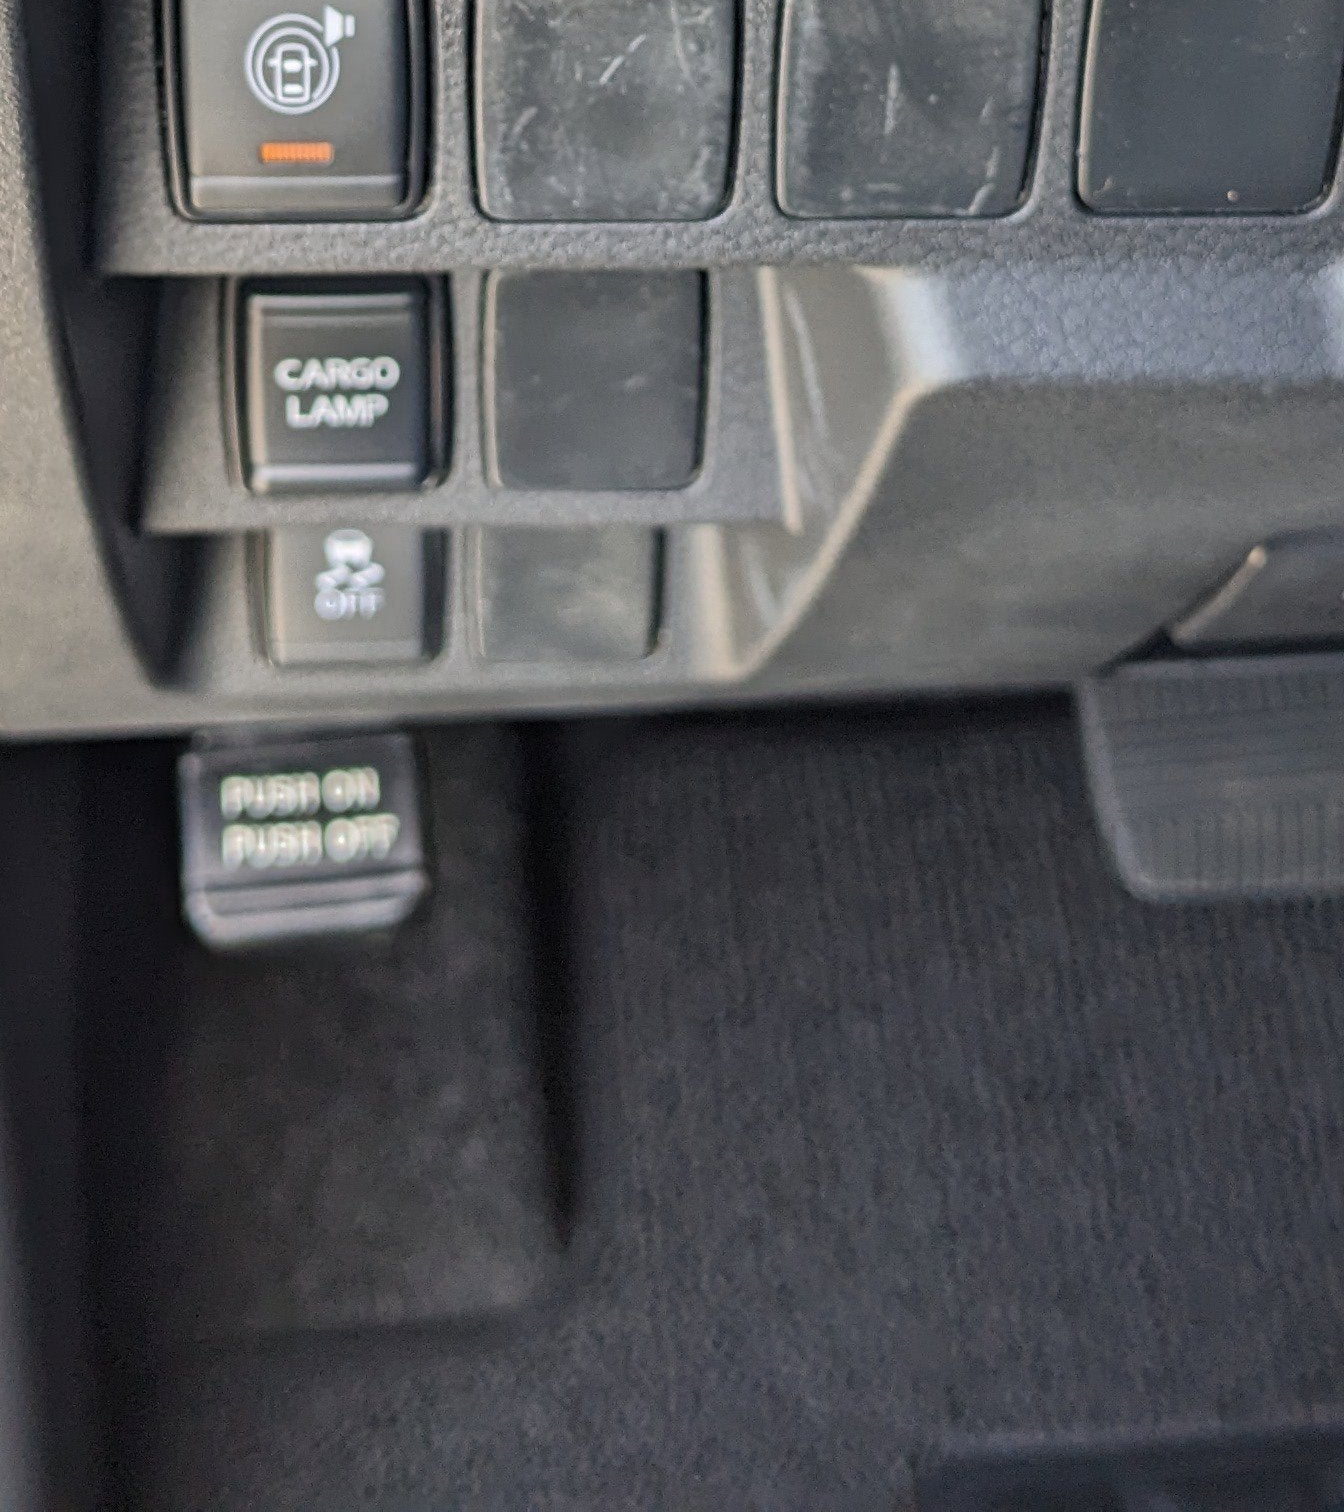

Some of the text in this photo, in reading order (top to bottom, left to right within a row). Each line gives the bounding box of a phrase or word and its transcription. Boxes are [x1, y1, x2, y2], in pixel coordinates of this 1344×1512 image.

[273, 355, 401, 391] CARGO
[285, 393, 389, 429] LAMP
[314, 588, 385, 621] OFF
[220, 770, 321, 819] PUSH
[221, 820, 323, 869] PUSH
